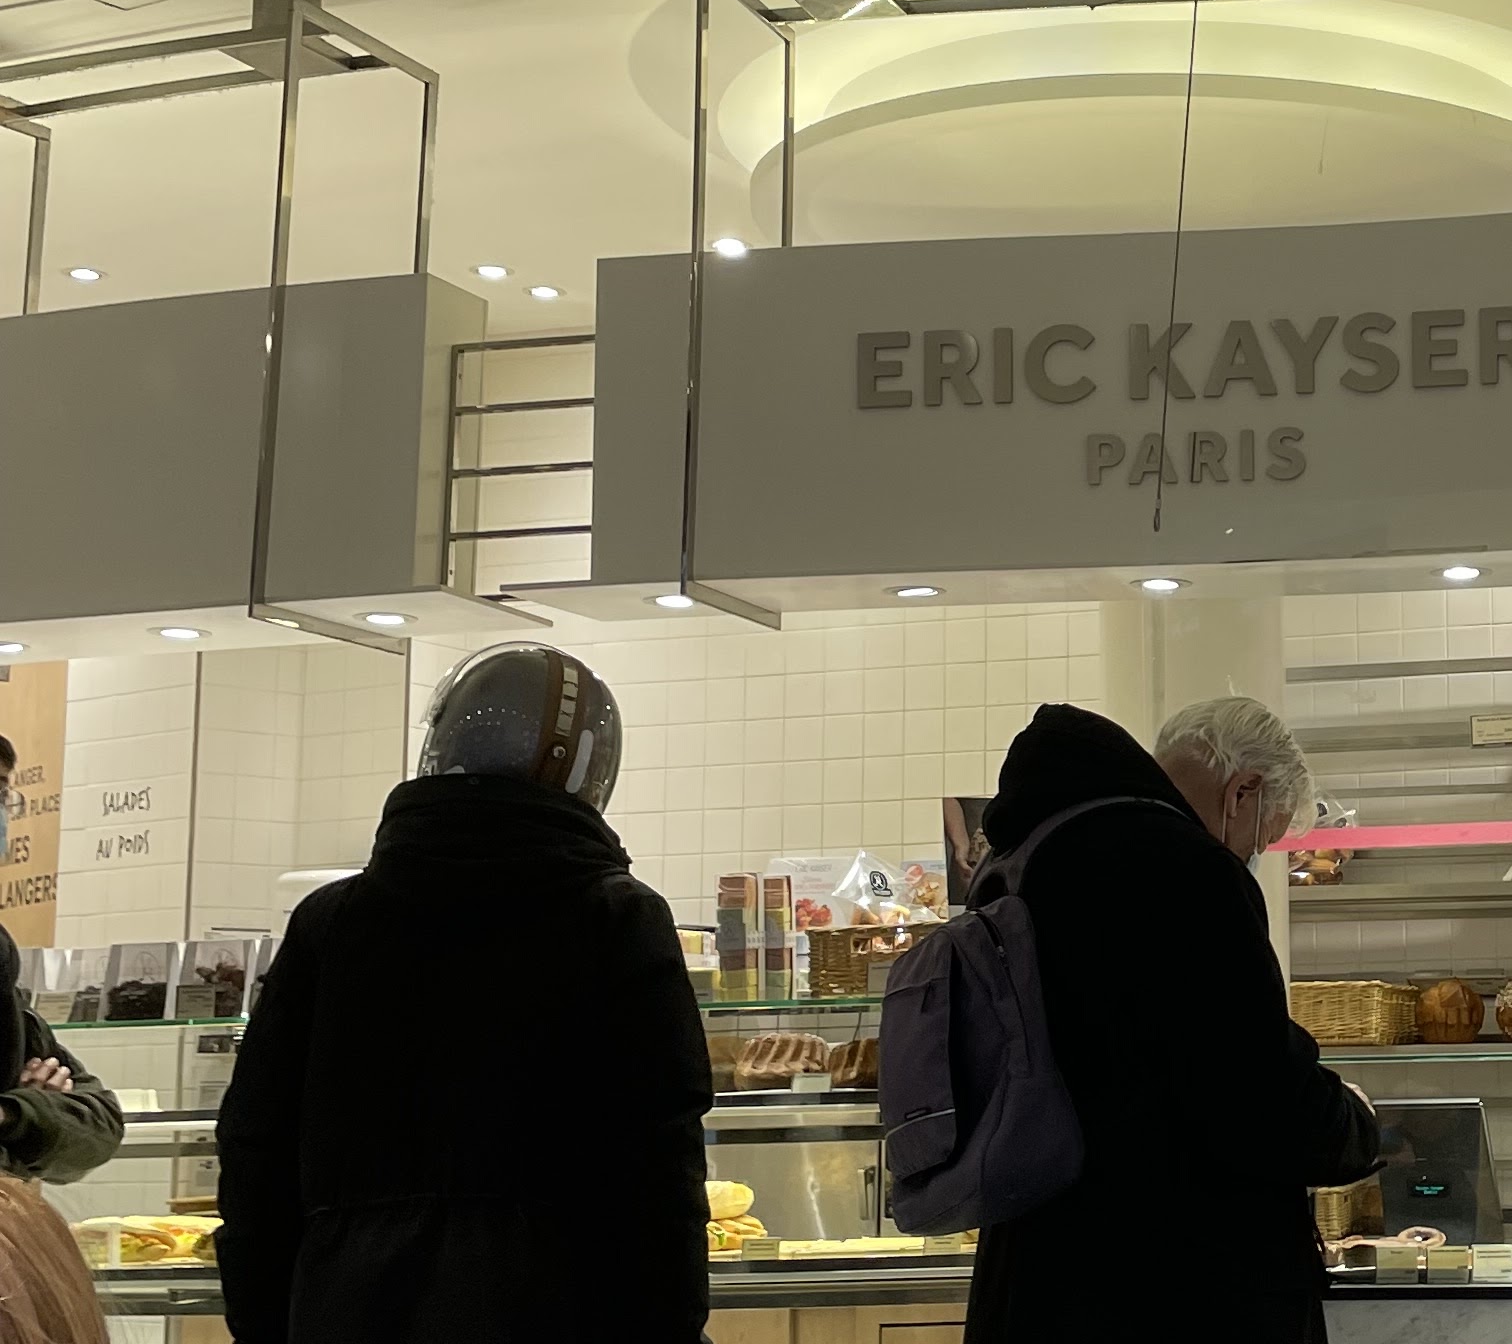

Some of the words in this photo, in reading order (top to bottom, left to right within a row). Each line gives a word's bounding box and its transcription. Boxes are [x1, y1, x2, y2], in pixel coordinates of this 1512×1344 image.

[856, 323, 1097, 409] ERIC
[1086, 426, 1306, 485] PARIS
[102, 786, 152, 816] SALADES
[96, 837, 113, 861] AU
[118, 830, 150, 858] POIDS
